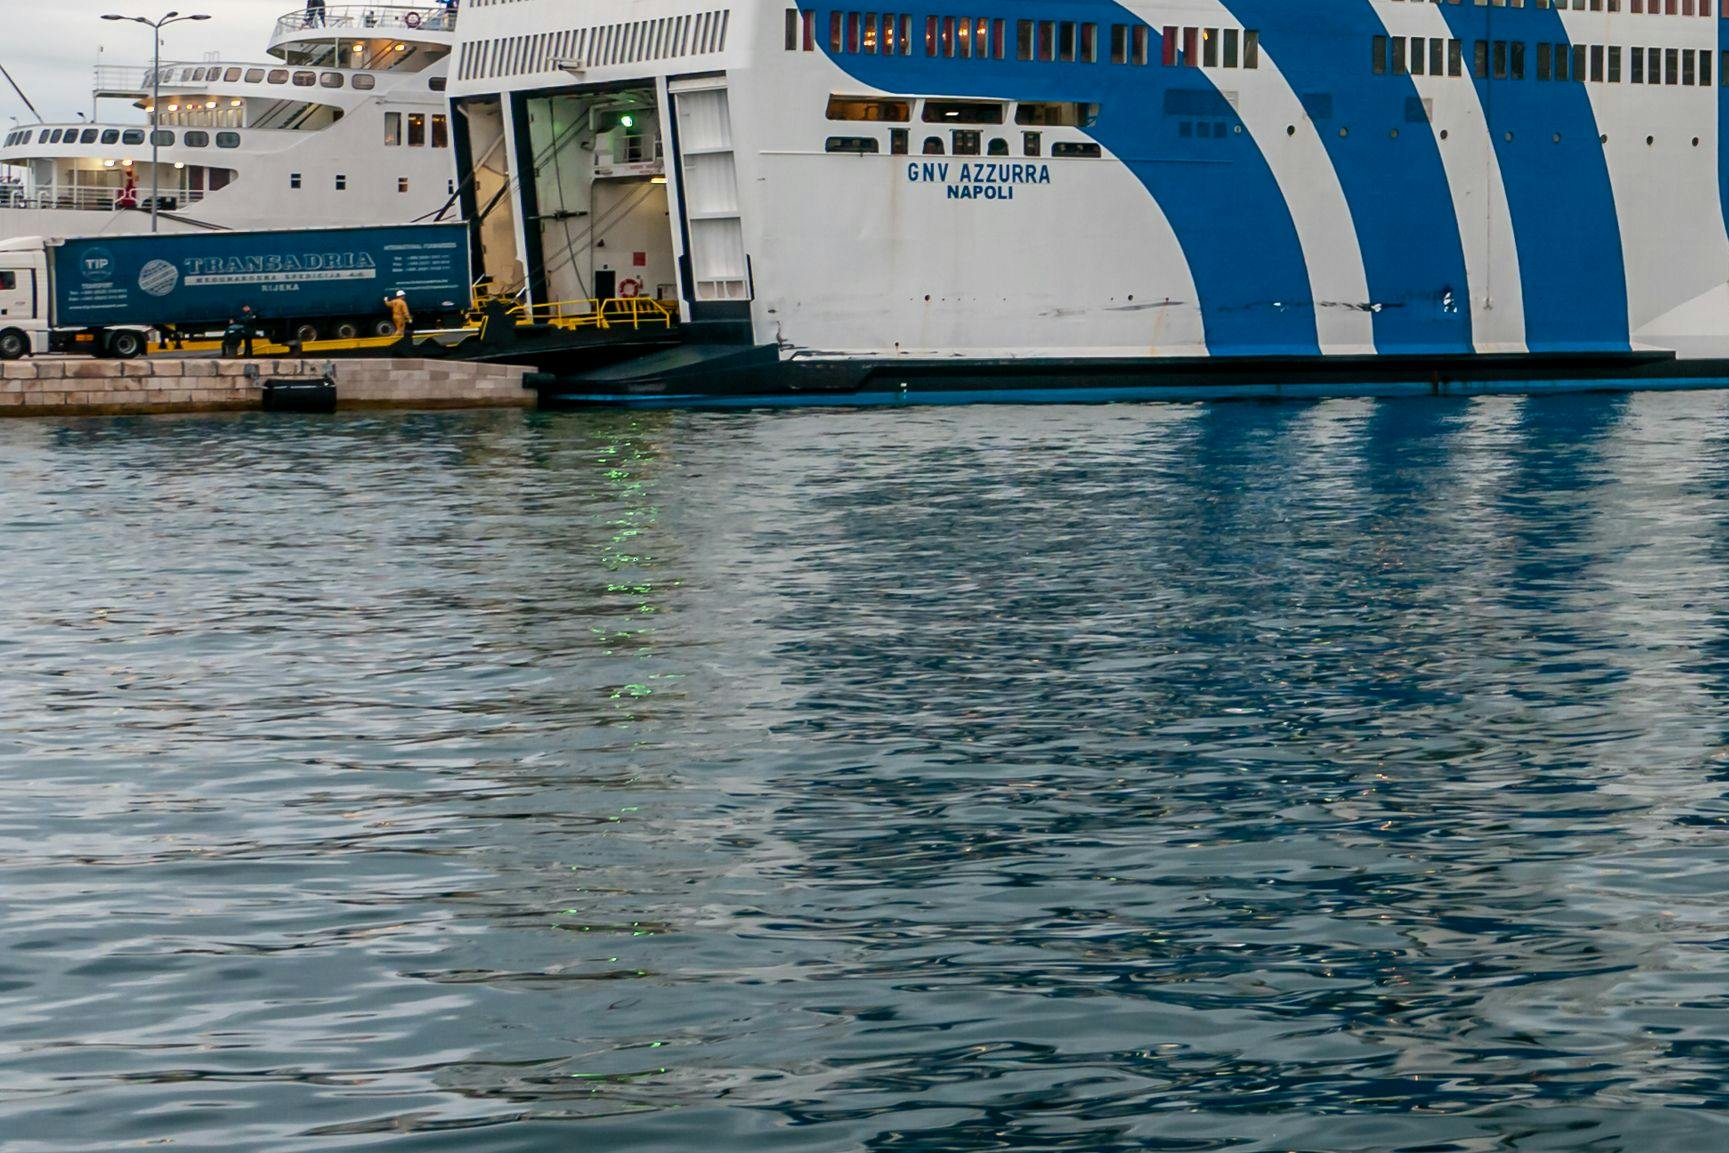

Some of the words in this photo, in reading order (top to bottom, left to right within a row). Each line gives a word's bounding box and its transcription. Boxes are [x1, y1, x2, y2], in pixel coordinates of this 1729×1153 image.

[908, 162, 949, 182] GNV
[960, 163, 1051, 184] AZZURRA
[947, 185, 1013, 199] NAPOLI
[85, 259, 108, 269] TIP
[184, 251, 376, 274] TRANSADRIA
